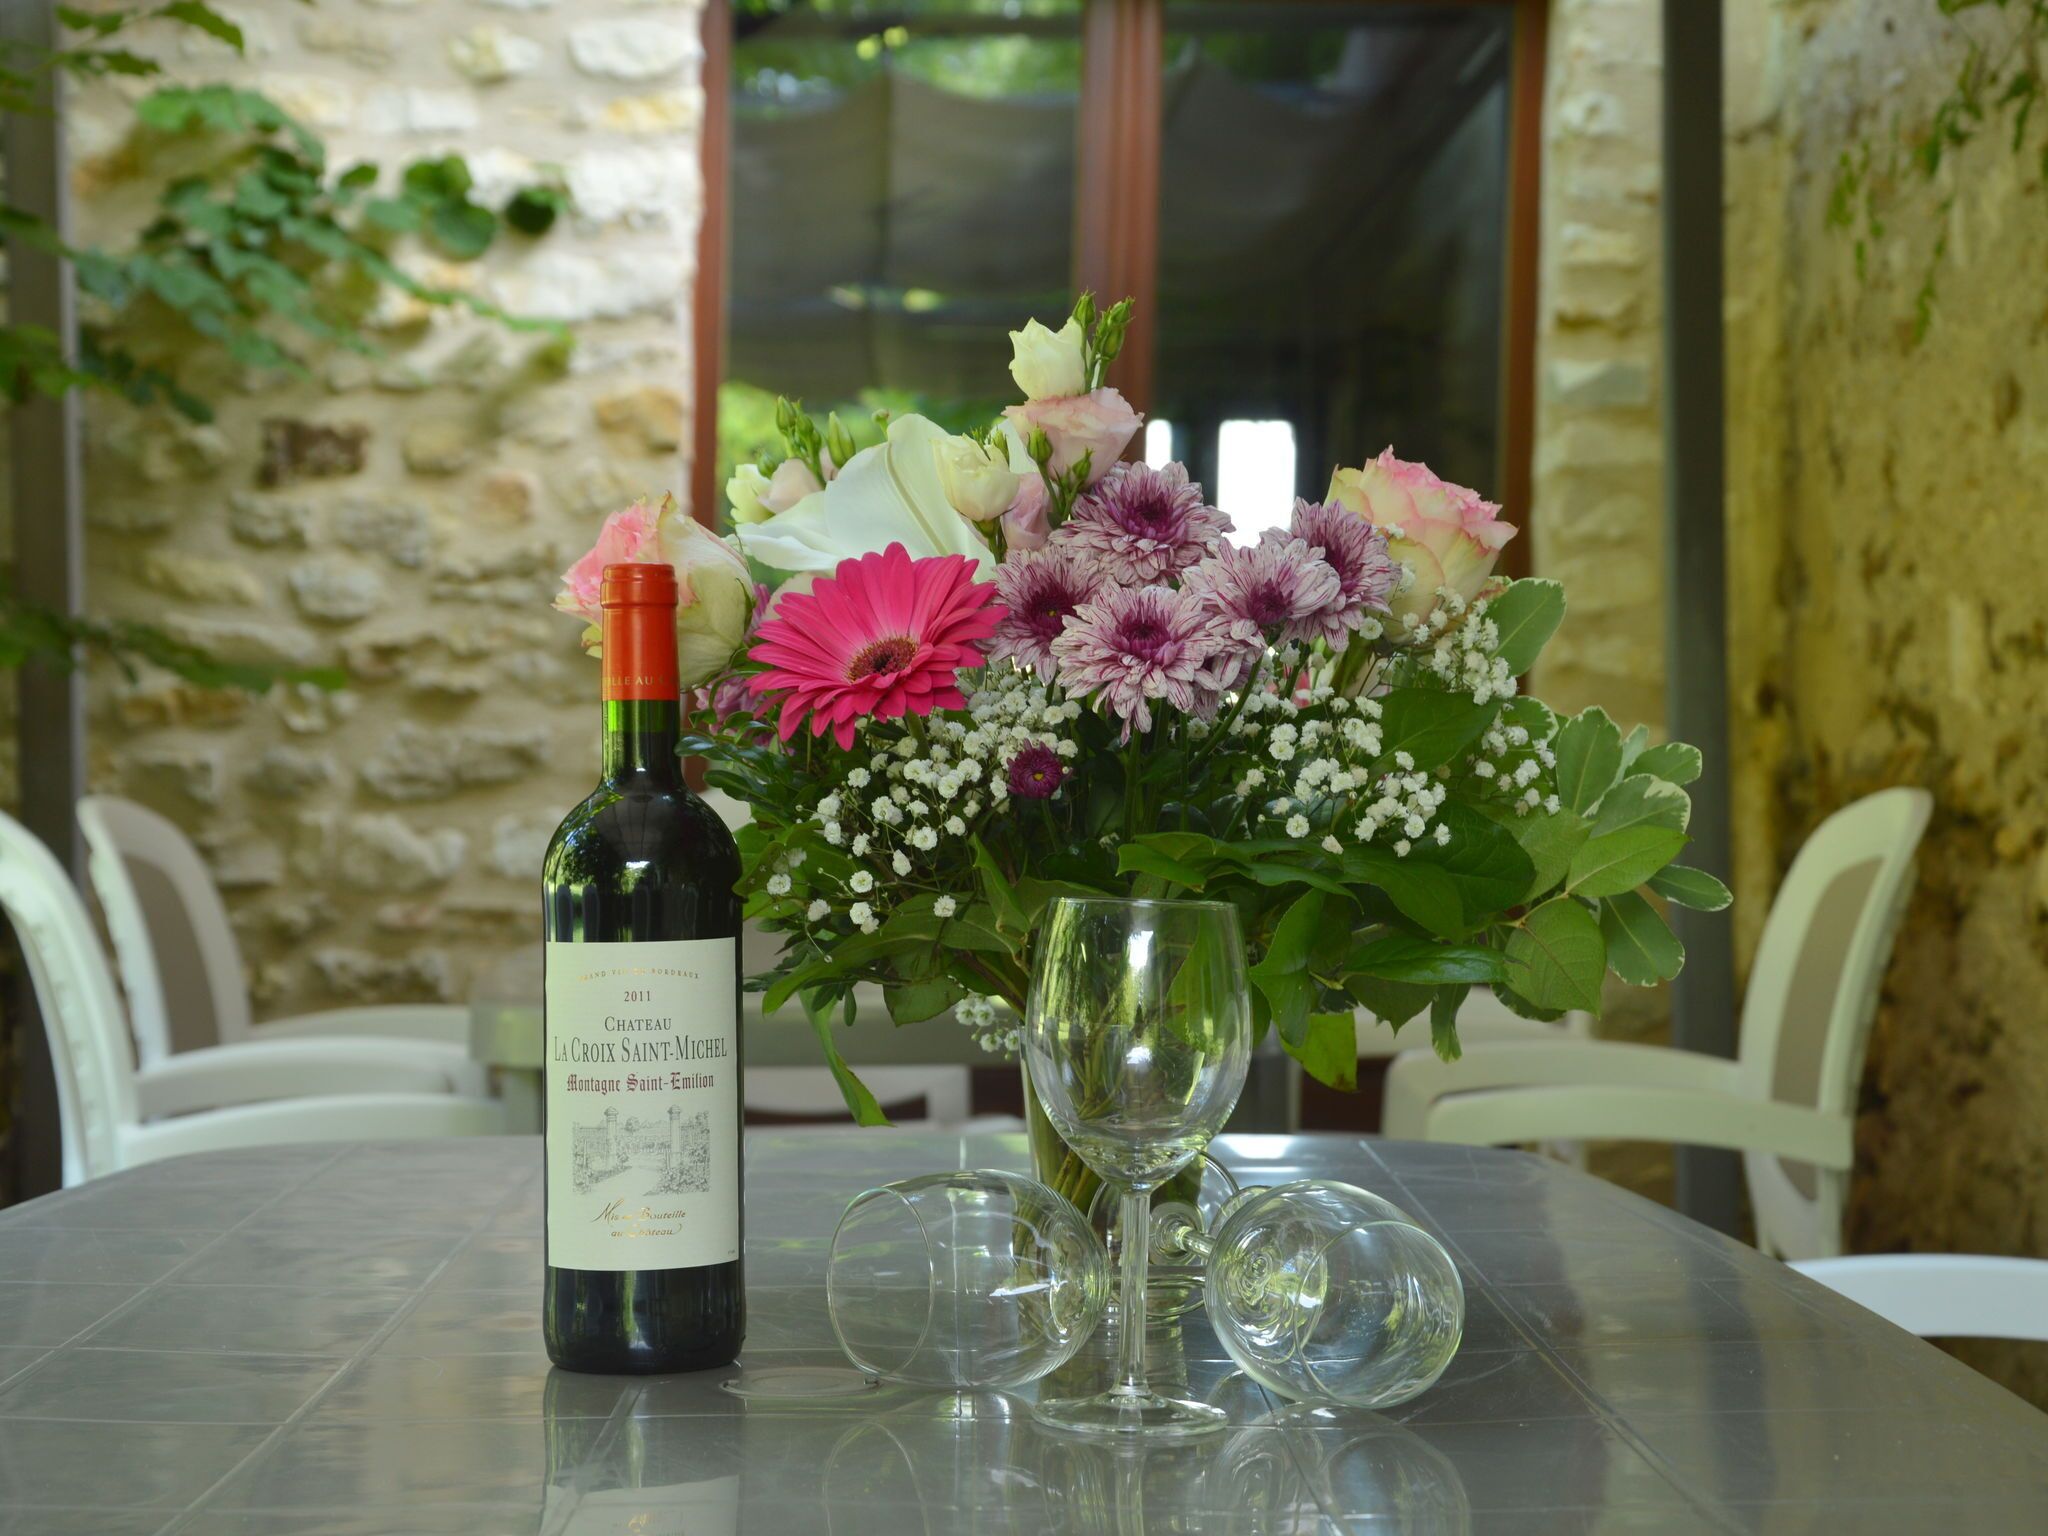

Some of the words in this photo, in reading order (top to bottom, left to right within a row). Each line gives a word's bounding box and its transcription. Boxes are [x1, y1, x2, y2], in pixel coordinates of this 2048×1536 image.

[652, 968, 700, 980] BORDEAUX
[623, 990, 652, 1002] 2011
[604, 1015, 672, 1032] CHATEAU
[554, 1036, 568, 1062] LA
[571, 1036, 616, 1063] CROIX
[621, 1035, 728, 1063] SAINT-MICHEL
[566, 1073, 621, 1096] Montagne
[626, 1071, 715, 1092] Saint-Emilion
[591, 1197, 624, 1225] Mis
[639, 1206, 687, 1222] Bouteille
